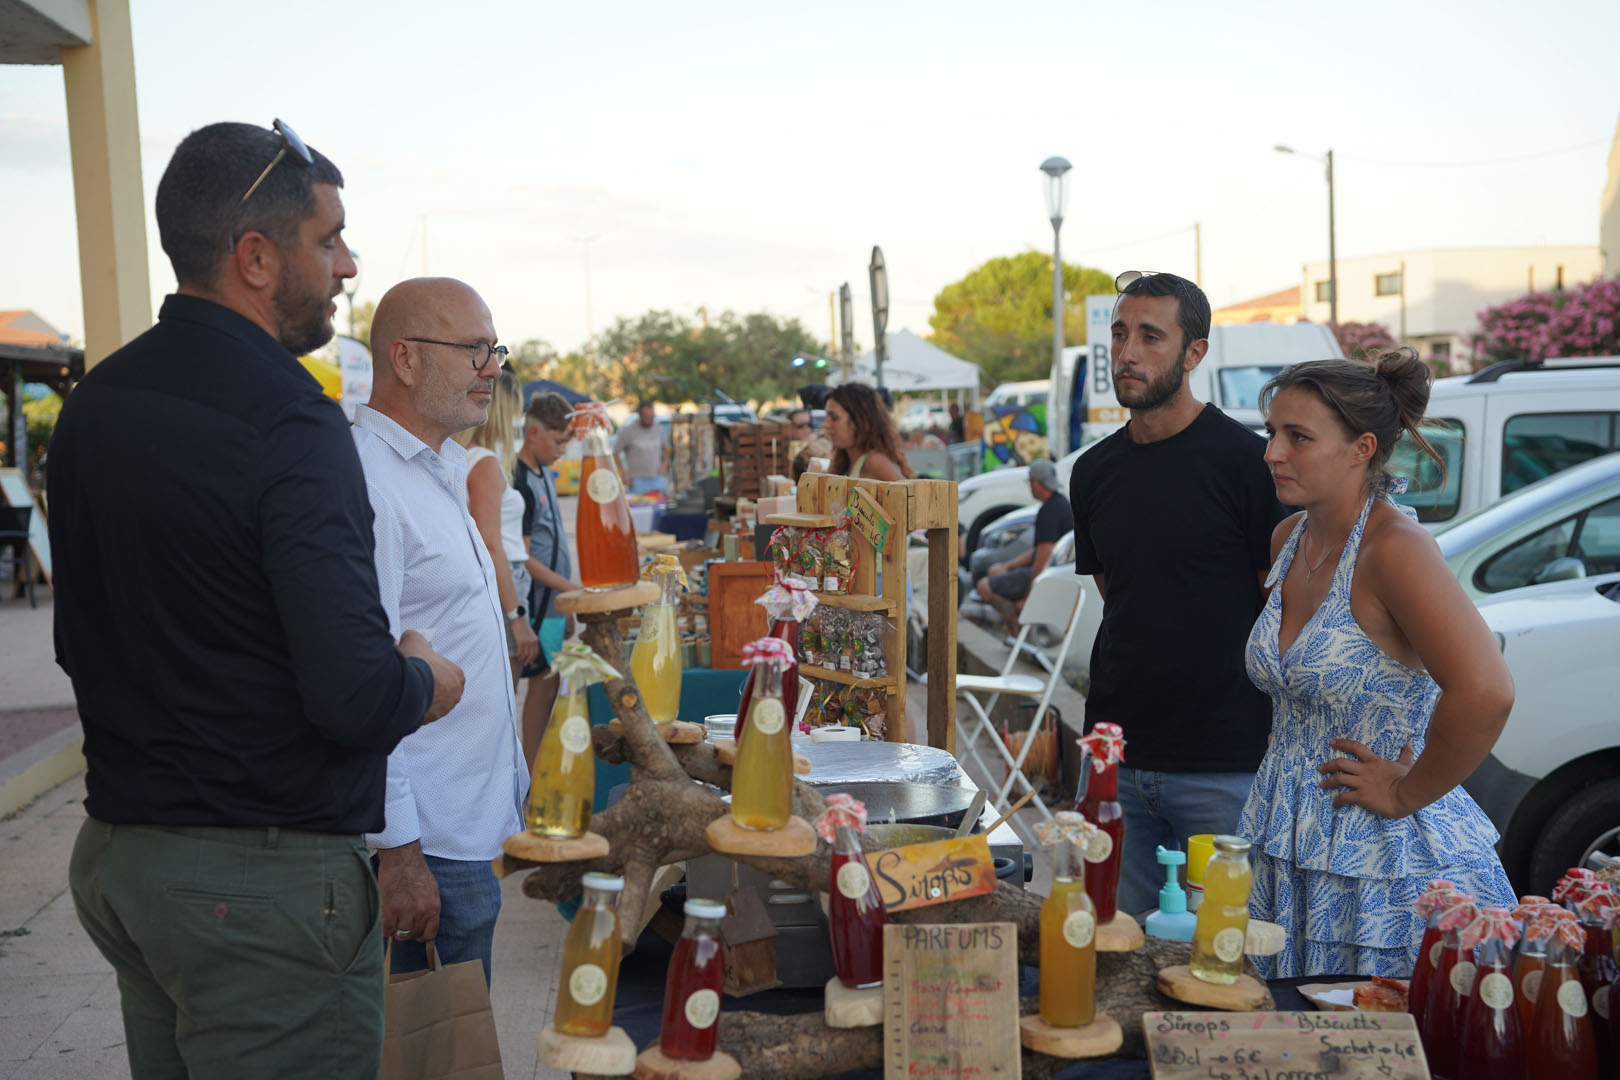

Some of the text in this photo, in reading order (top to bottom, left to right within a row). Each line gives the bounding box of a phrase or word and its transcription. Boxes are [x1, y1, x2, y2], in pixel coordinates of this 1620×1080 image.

[876, 851, 972, 908] Sirops
[903, 924, 1004, 951] PARFUMS
[1156, 1012, 1231, 1041] Sirops
[1290, 1011, 1382, 1034] Biscuits
[1320, 1034, 1376, 1056] Sachet
